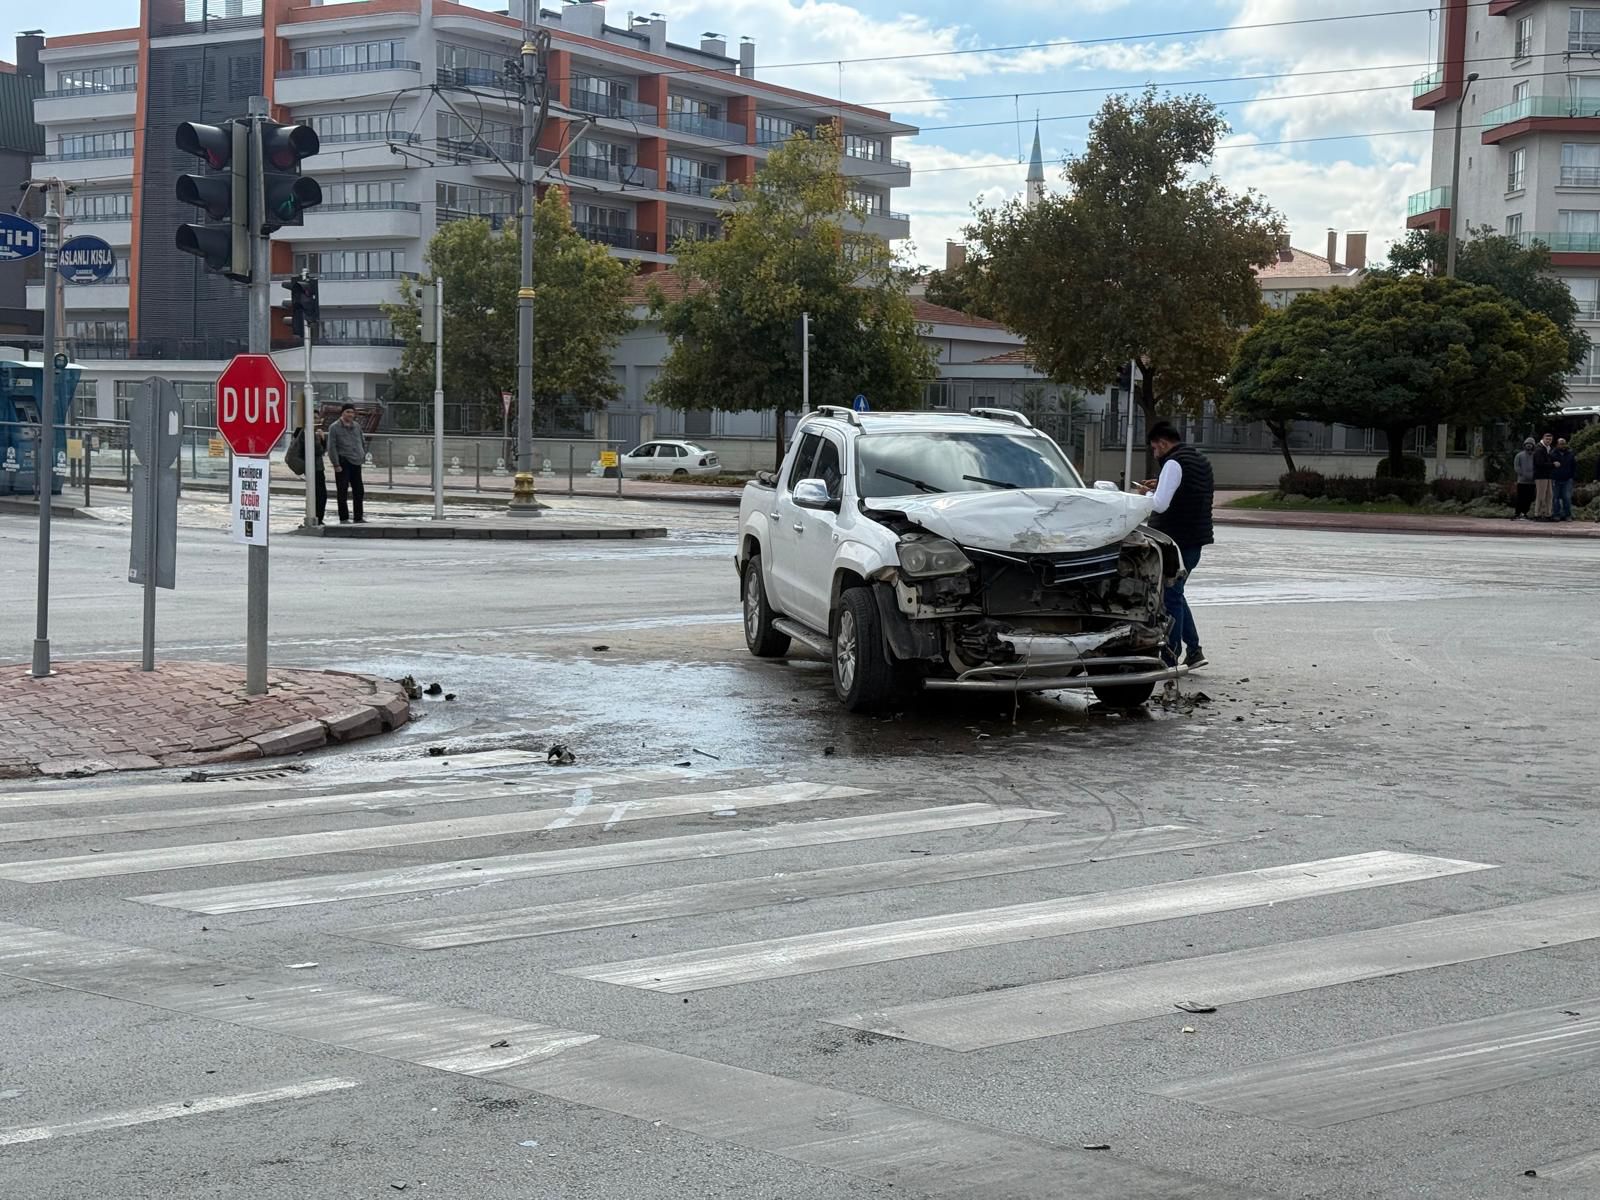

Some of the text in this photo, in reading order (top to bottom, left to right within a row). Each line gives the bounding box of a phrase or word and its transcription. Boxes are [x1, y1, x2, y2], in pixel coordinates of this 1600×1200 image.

[60, 249, 112, 269] ASLANLI KIŞLA
[223, 387, 280, 424] DUR
[240, 491, 260, 507] ÖZGÜR
